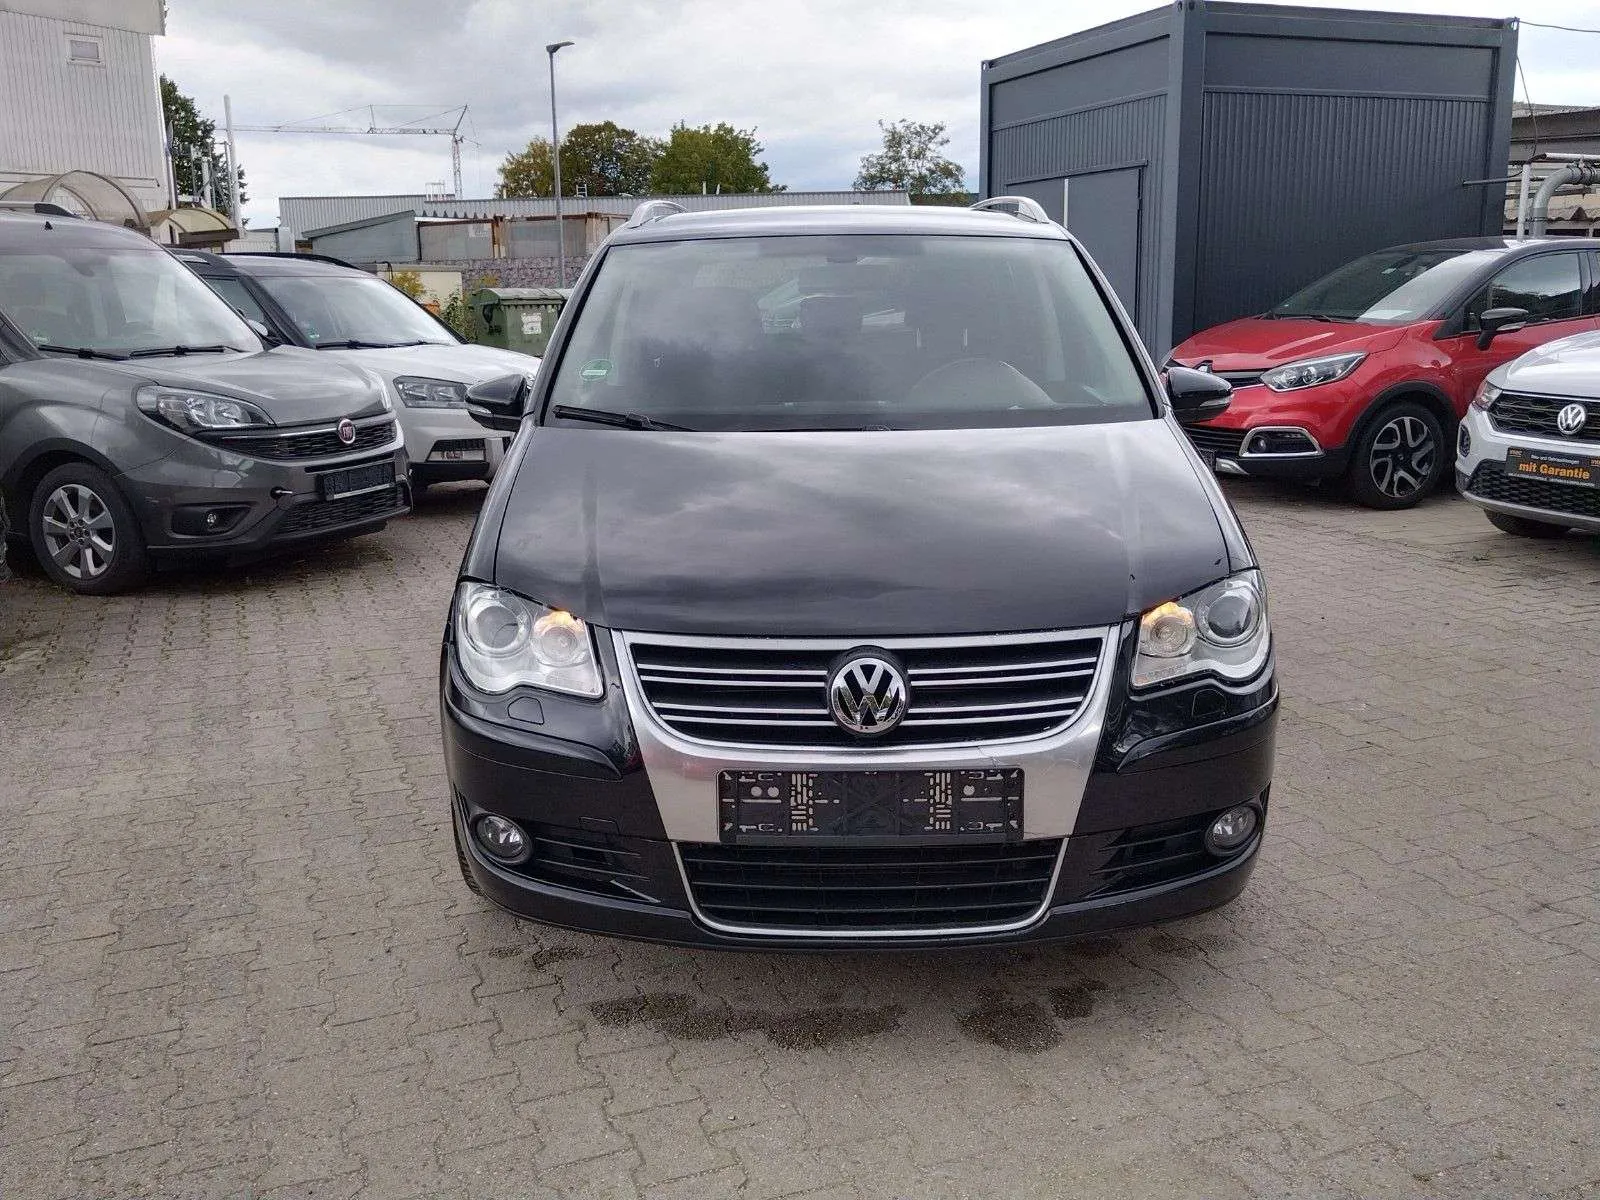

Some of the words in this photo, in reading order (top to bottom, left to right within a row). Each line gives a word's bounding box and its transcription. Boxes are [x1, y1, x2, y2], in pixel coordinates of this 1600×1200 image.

[1519, 462, 1537, 473] mit
[1540, 464, 1590, 480] Garantie
[834, 658, 904, 730] VW
